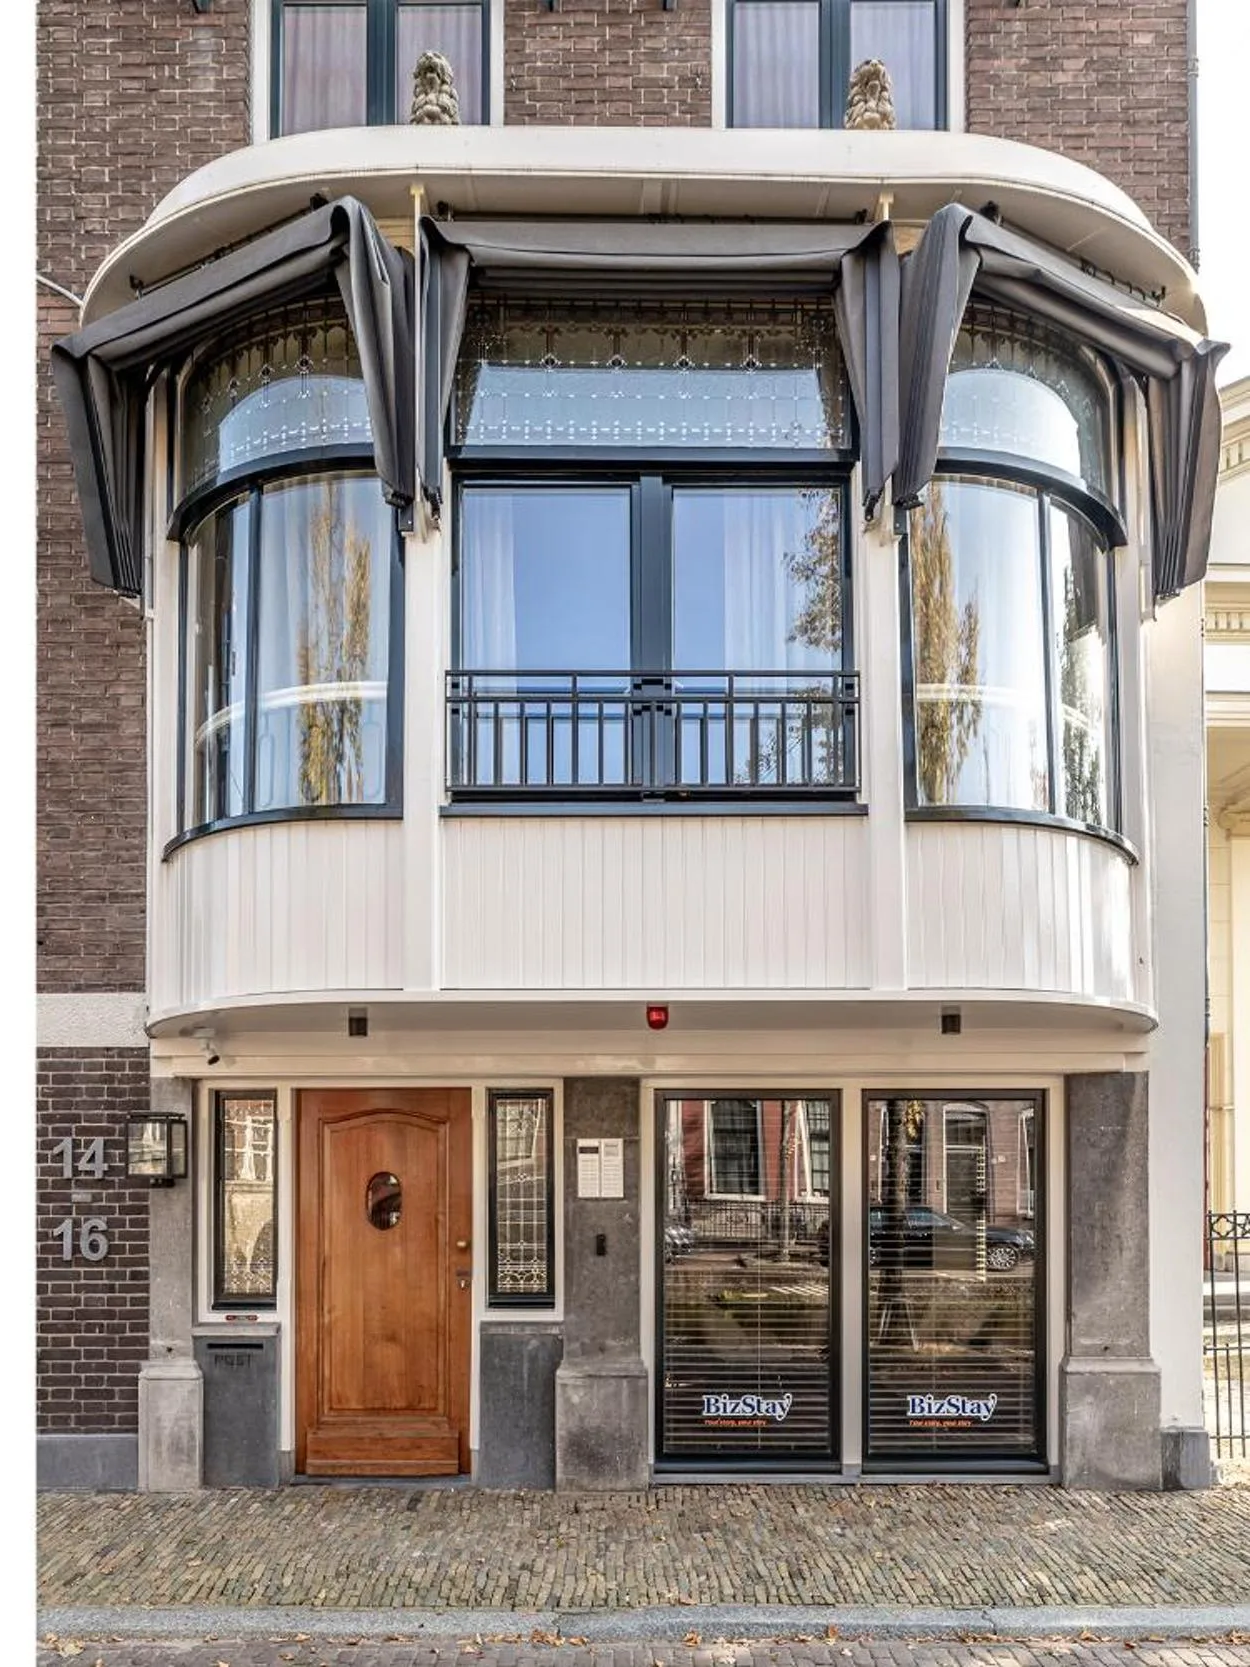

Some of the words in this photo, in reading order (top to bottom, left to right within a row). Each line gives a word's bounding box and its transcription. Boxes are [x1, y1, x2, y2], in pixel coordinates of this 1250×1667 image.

[53, 1136, 109, 1179] 14
[53, 1218, 109, 1261] 16
[702, 1393, 792, 1420] BizStay
[907, 1393, 997, 1420] BizStay
